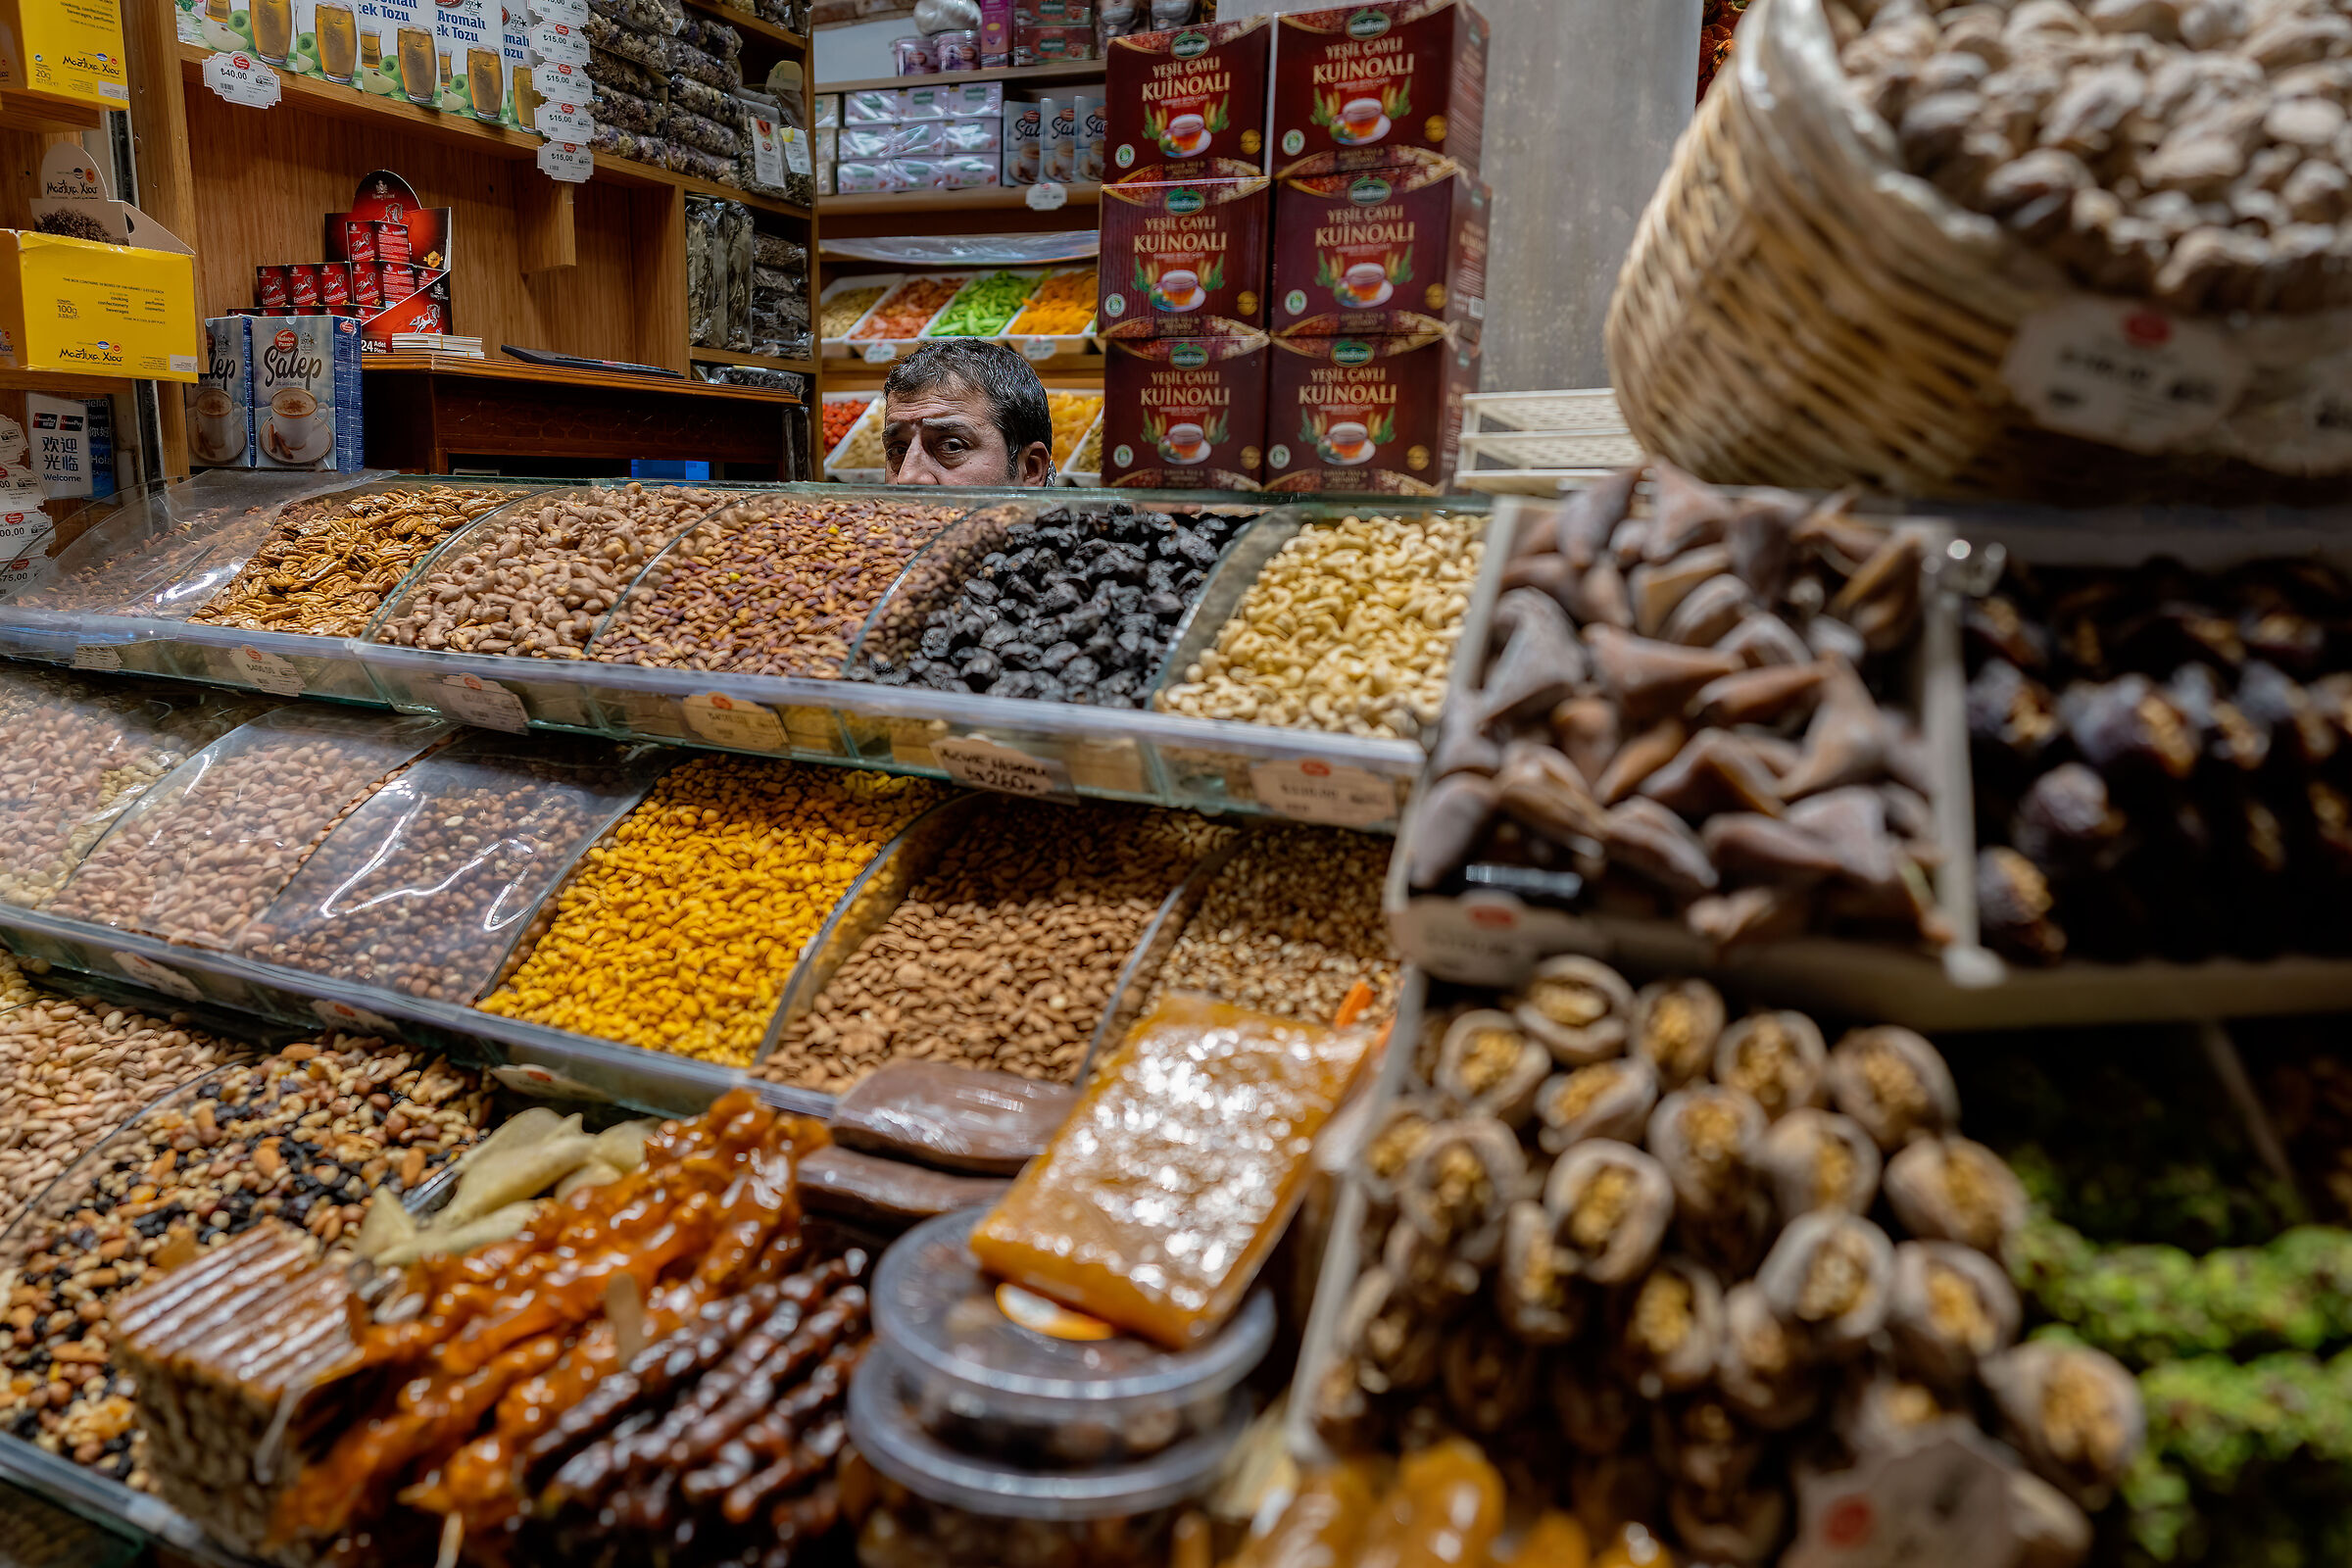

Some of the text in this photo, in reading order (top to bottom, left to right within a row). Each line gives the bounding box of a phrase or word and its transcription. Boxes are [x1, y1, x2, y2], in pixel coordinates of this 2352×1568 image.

[359, 2, 411, 23] ek Tozu
[438, 9, 486, 30] Aromalı
[451, 26, 479, 42] Tozu
[504, 33, 529, 48] malı
[504, 45, 524, 60] ozu
[35, 69, 51, 80] 20g
[1052, 117, 1074, 139] Sa
[58, 305, 77, 316] 100g
[362, 340, 373, 352] 24
[265, 345, 322, 391] Salep
[41, 436, 78, 454] 欢迎
[43, 455, 79, 471] 光临
[43, 472, 82, 483] Welcome
[0, 572, 27, 582] 75,00
